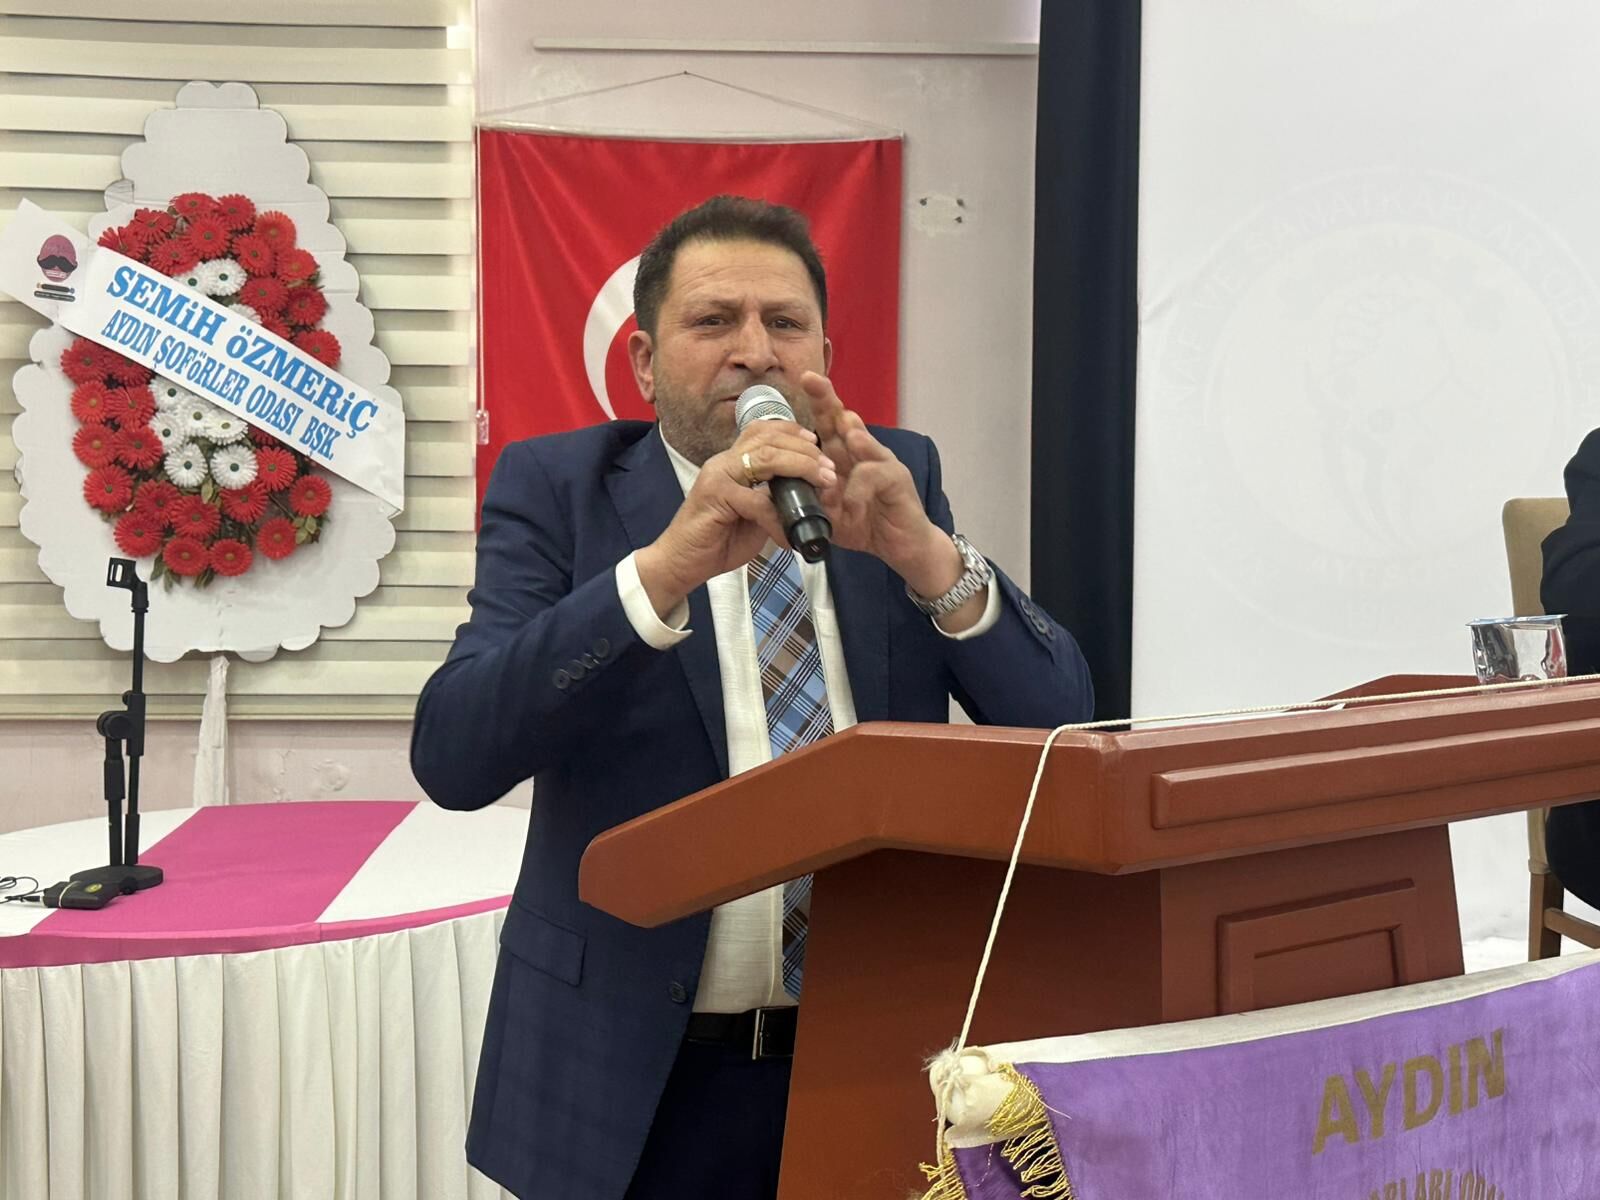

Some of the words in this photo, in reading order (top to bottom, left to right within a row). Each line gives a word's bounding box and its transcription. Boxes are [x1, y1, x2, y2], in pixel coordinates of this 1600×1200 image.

[103, 311, 159, 356] AYDIN
[246, 384, 303, 435] ODASI
[1312, 1027, 1505, 1157] AYDIN
